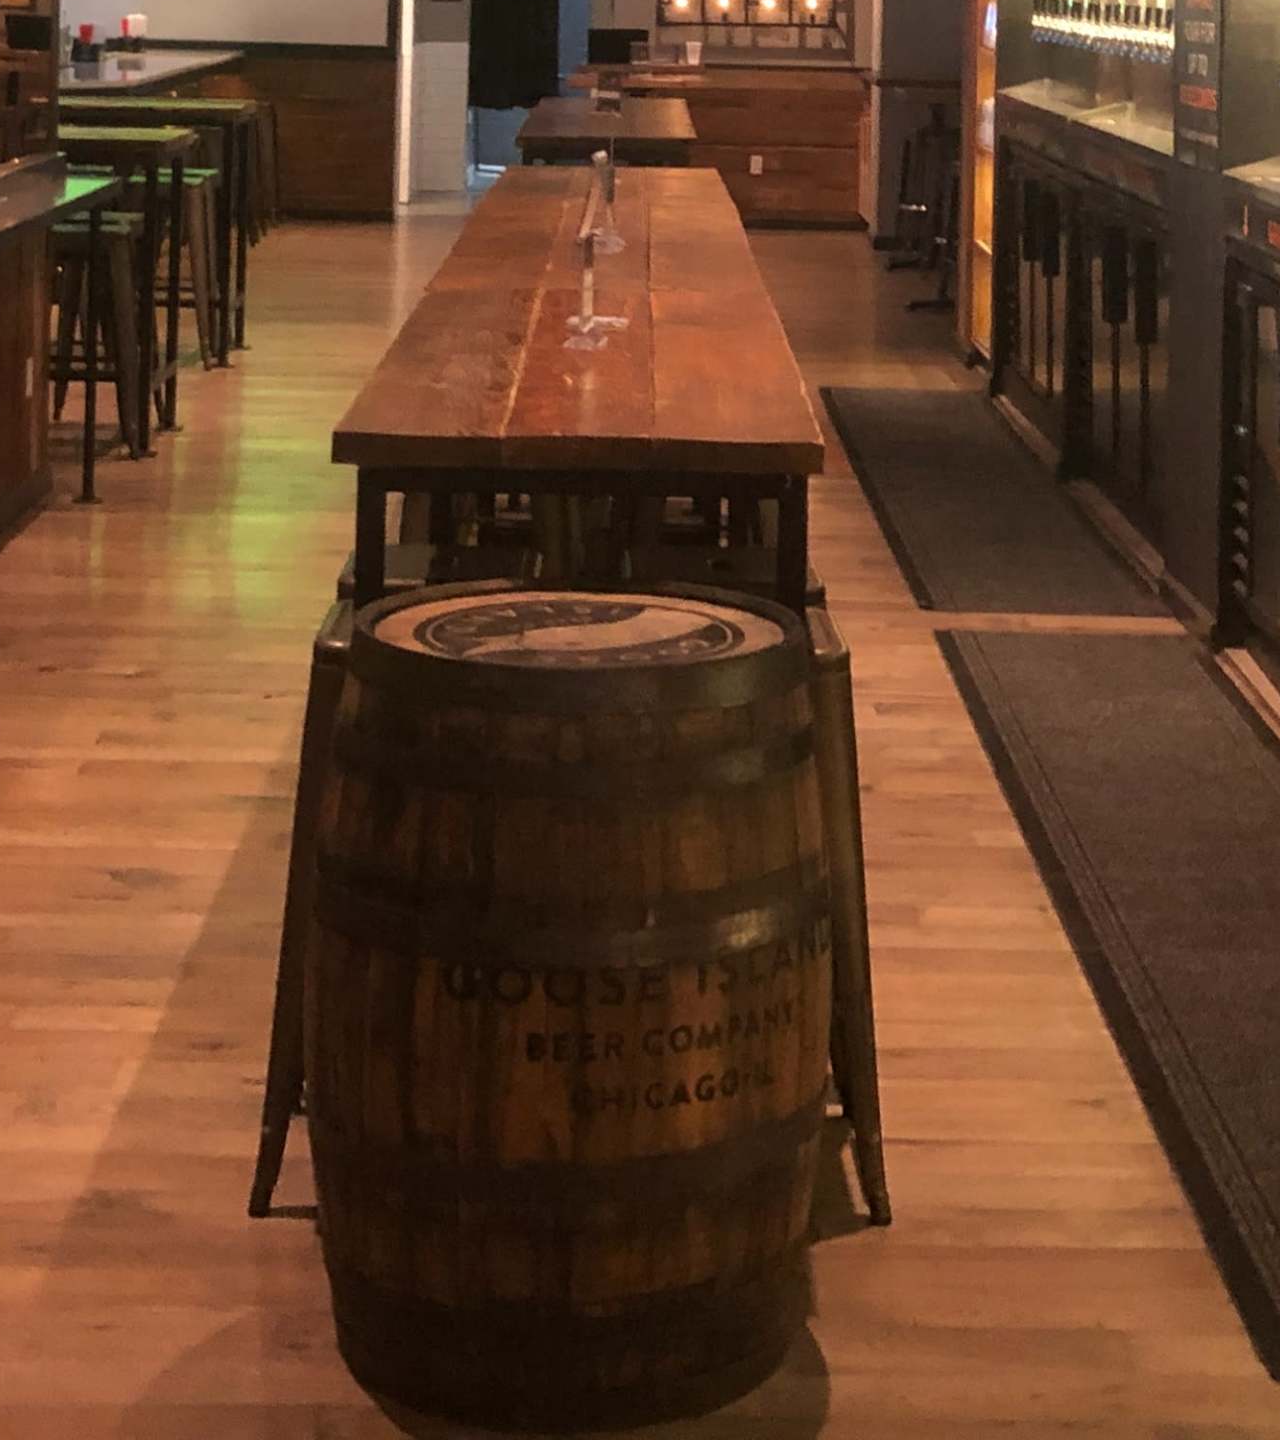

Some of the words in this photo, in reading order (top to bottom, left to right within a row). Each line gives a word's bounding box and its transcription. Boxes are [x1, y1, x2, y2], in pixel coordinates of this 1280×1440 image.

[526, 1030, 626, 1063] BEER
[641, 1000, 795, 1057] COMPANY
[573, 1068, 739, 1115] CHICAGO
